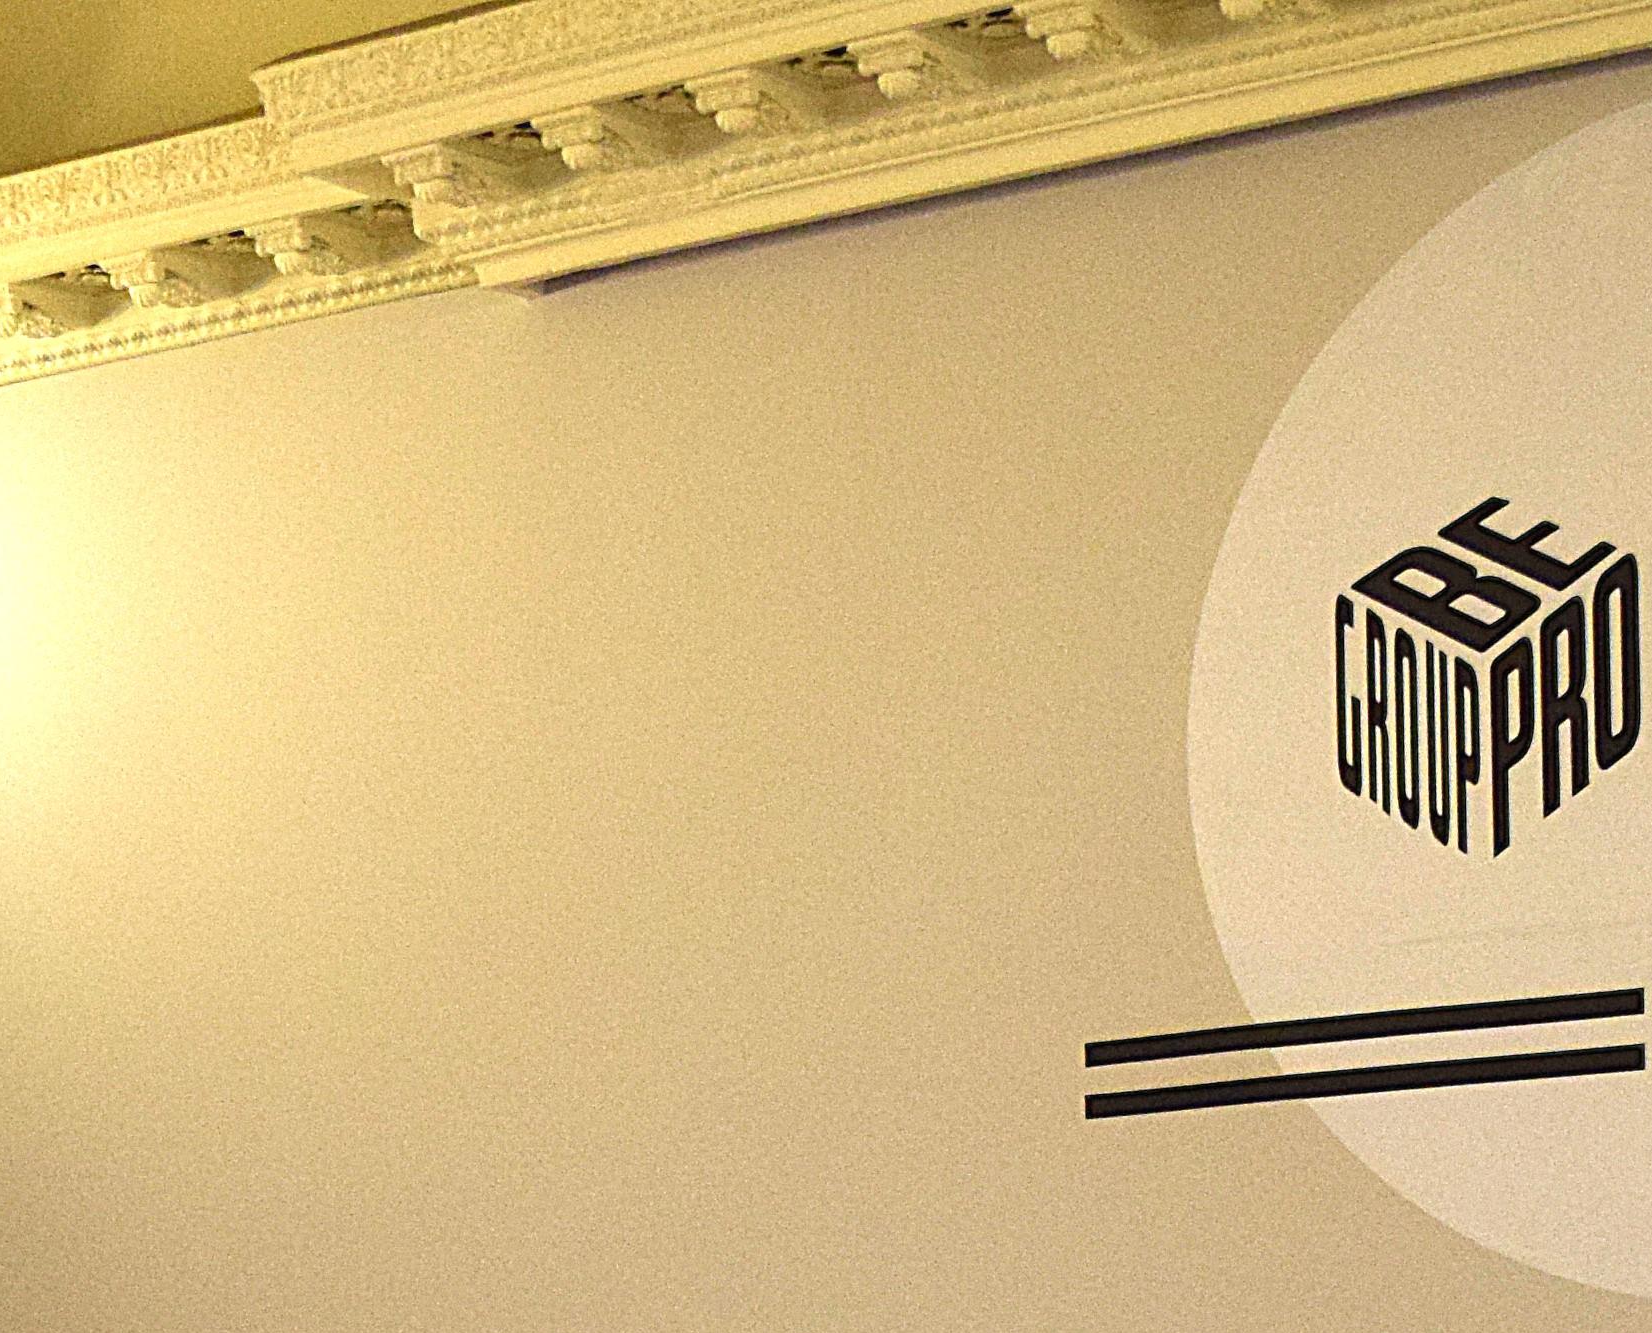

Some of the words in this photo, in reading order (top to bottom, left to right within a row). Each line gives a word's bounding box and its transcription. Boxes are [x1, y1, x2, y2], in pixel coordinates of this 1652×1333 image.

[1351, 496, 1617, 653] BE
[1489, 553, 1641, 858] PRO
[1335, 593, 1481, 855] GROUP
